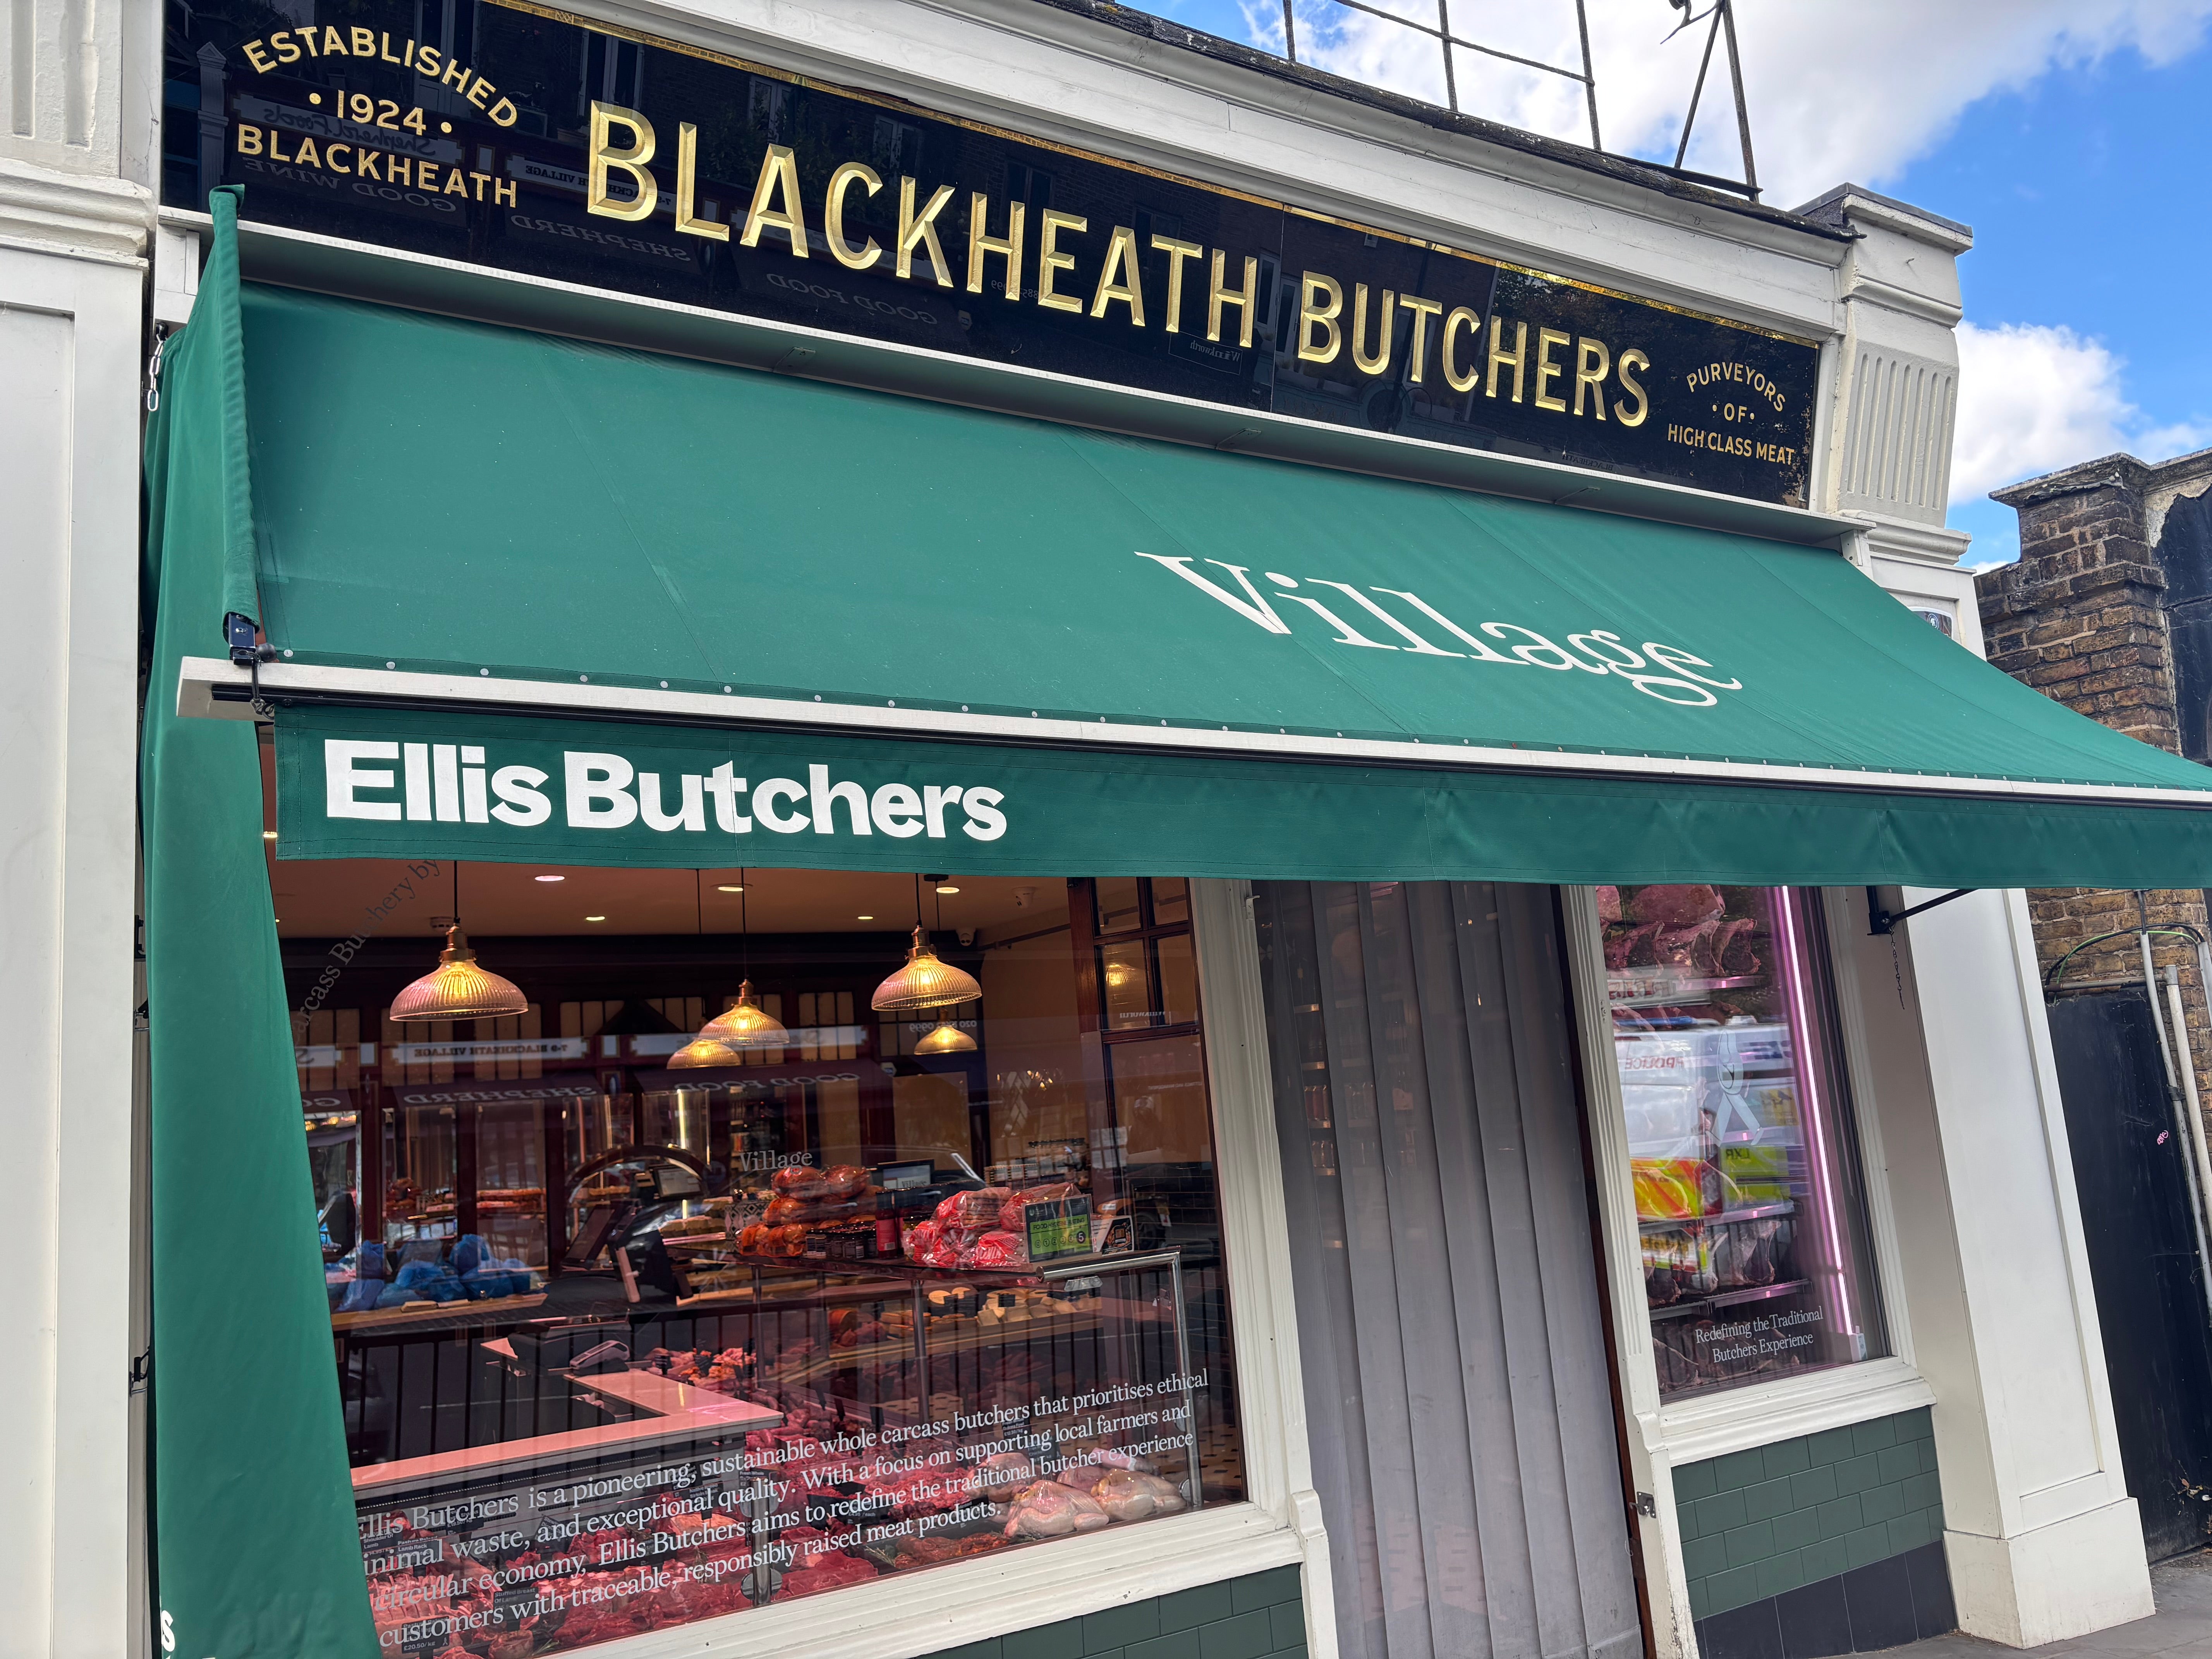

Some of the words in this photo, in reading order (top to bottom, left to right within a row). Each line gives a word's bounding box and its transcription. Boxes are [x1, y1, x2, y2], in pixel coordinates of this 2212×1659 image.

[242, 26, 517, 127] ESTABLISHED
[338, 89, 427, 135] 1924
[238, 124, 517, 208] BLACKHEATH
[587, 100, 1257, 347] BLACKHEATH
[1298, 270, 1650, 426] BUTCHERS
[1686, 361, 1785, 412] PURVEYORS
[1724, 403, 1747, 423] OF
[1668, 423, 1704, 448] HIGH
[1708, 432, 1752, 457] CLASS
[1756, 445, 1795, 465] MEAT
[1134, 551, 1743, 706] Village
[325, 739, 552, 827] Ellis
[563, 750, 1007, 842] Butchers
[328, 877, 416, 965] Butchery
[740, 1150, 813, 1174] Village
[1078, 1232, 1084, 1242] 5
[1695, 1321, 1752, 1344] Redefining
[1753, 1317, 1770, 1332] the
[1769, 1306, 1824, 1329] Traditional
[1712, 1343, 1757, 1363] Butchers
[1759, 1334, 1814, 1354] Experience
[411, 1491, 519, 1530] Butchers
[528, 1487, 547, 1508] is
[554, 1487, 567, 1503] a
[572, 1463, 696, 1508] pioneering,
[702, 1439, 815, 1476] sustainable
[820, 1428, 877, 1454] whole
[881, 1419, 949, 1441] carcass
[954, 1404, 1030, 1431] butchers
[1034, 1394, 1069, 1416] that
[1073, 1382, 1153, 1410] prioritises
[1158, 1368, 1209, 1394] ethical
[450, 1530, 529, 1558] waste,
[538, 1513, 581, 1542] and
[587, 1488, 713, 1533] exceptional
[718, 1480, 796, 1508] quality.
[802, 1463, 854, 1490] With
[859, 1465, 869, 1478] a
[875, 1456, 924, 1477] focus
[929, 1451, 951, 1466] on
[956, 1428, 1051, 1464] supporting
[1055, 1417, 1093, 1443] local
[1097, 1410, 1158, 1433] farmers
[1162, 1400, 1191, 1420] and
[376, 1575, 473, 1611] circular
[479, 1554, 586, 1589] economy,
[599, 1539, 647, 1566] Ellis
[653, 1518, 746, 1554] Butchers
[751, 1510, 800, 1534] aims
[805, 1504, 826, 1523] to
[830, 1488, 907, 1517] redefine
[912, 1480, 940, 1501] the
[946, 1458, 1036, 1494] traditional
[1040, 1448, 1104, 1475] butcher
[1109, 1433, 1194, 1463] experience
[380, 1605, 504, 1647] customers
[510, 1588, 564, 1620] with
[571, 1569, 678, 1607] traceable,
[683, 1540, 799, 1582] responsibly
[804, 1524, 862, 1556] raised
[867, 1518, 914, 1543] meat
[919, 1502, 1001, 1537] products.
